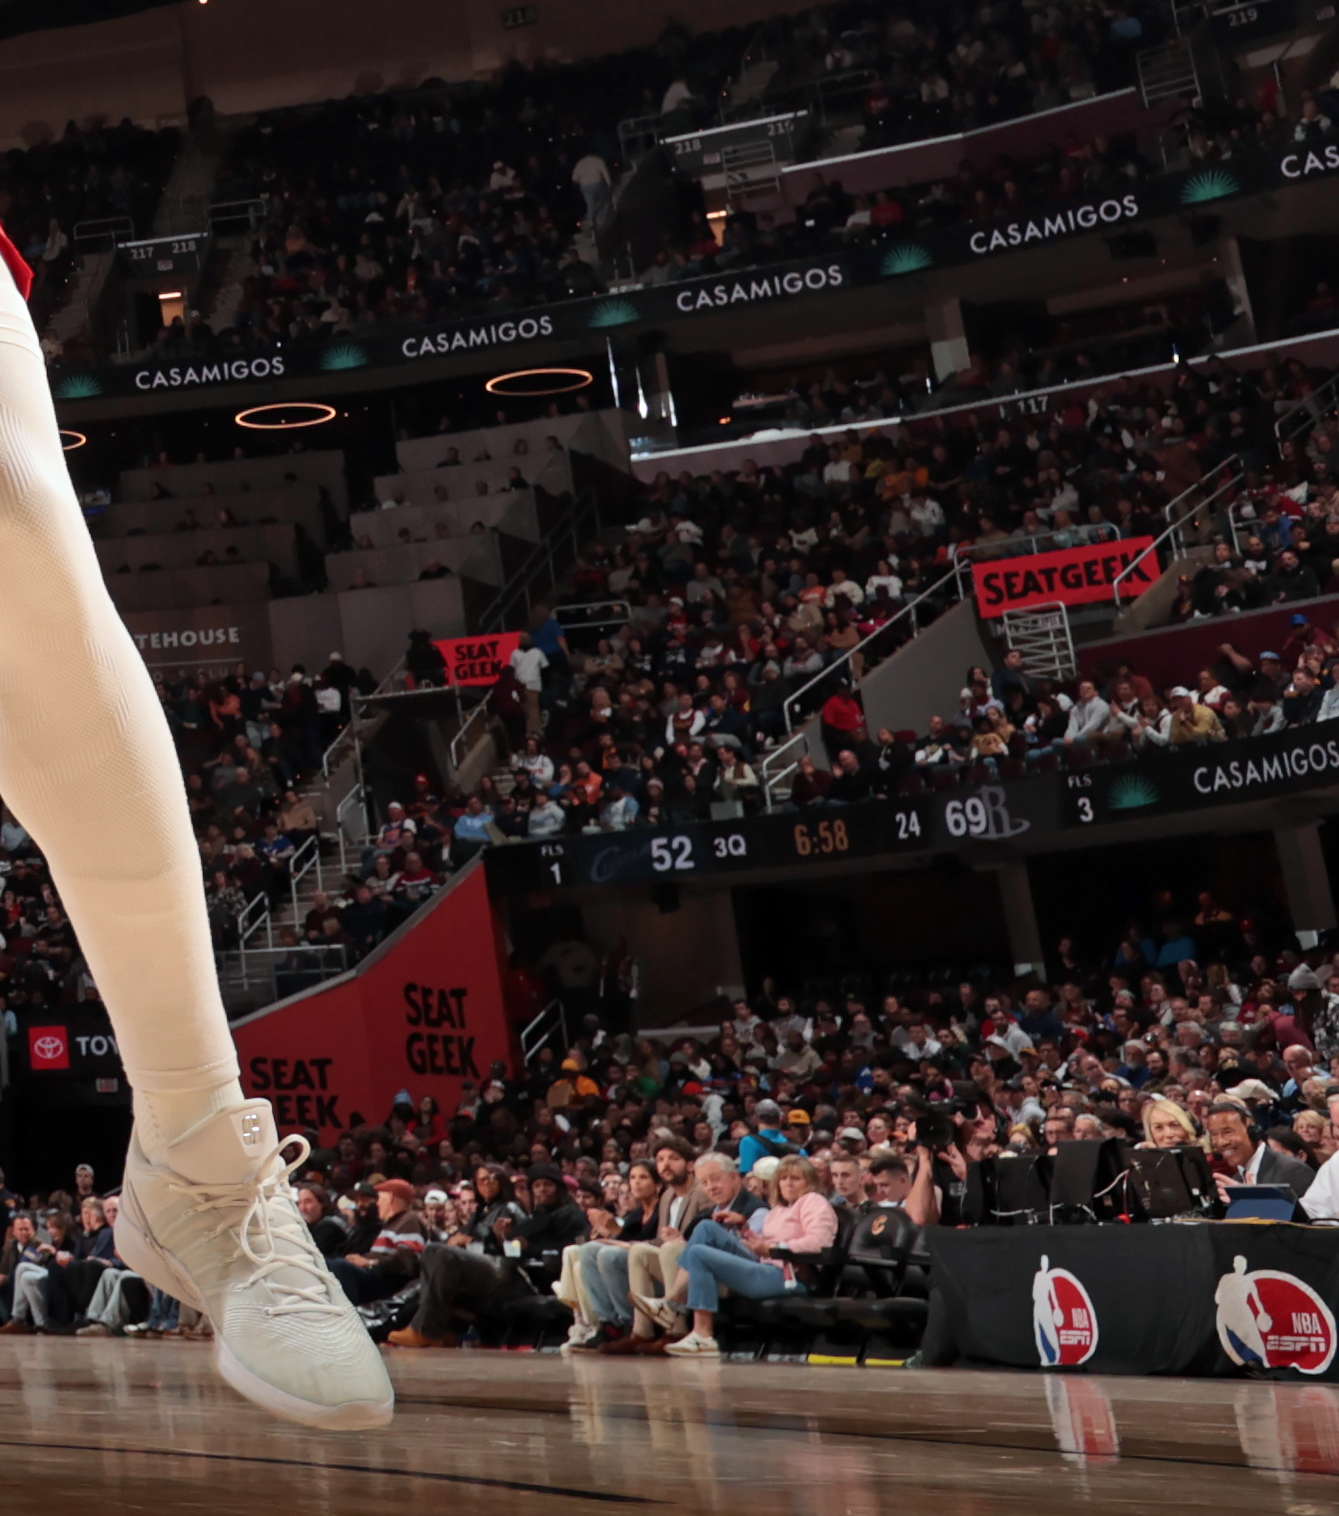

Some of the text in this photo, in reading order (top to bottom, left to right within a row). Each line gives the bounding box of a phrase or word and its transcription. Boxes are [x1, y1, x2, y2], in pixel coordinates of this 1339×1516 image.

[970, 194, 1138, 254] CASAMIGOS
[677, 265, 843, 312] CASAMIGOS
[402, 315, 553, 357] CASAMIGOS
[135, 357, 285, 390] CASAMIGOS
[983, 548, 1152, 606] SEATGEEK
[137, 627, 240, 650] TEHOUSE
[455, 640, 500, 661] SEAT
[455, 660, 503, 681] GEEK
[1067, 774, 1092, 789] FLS
[1194, 740, 1339, 794] CASAMIGOS
[945, 796, 986, 837] 69
[1078, 797, 1094, 823] 3
[541, 844, 564, 856] FLS
[714, 810, 921, 858] 3Q 6:58 24
[650, 834, 695, 872] 52
[550, 862, 561, 884] 1
[403, 982, 468, 1030] SEAT
[76, 1035, 119, 1057] TOY
[405, 1031, 481, 1079] GEEK
[250, 1056, 333, 1090] SEAT
[266, 1095, 343, 1129] EEK
[1071, 1308, 1089, 1328] NBA
[1291, 1312, 1322, 1334] NBA
[1060, 1329, 1090, 1345] ESPN
[1266, 1335, 1326, 1353] ESPN
